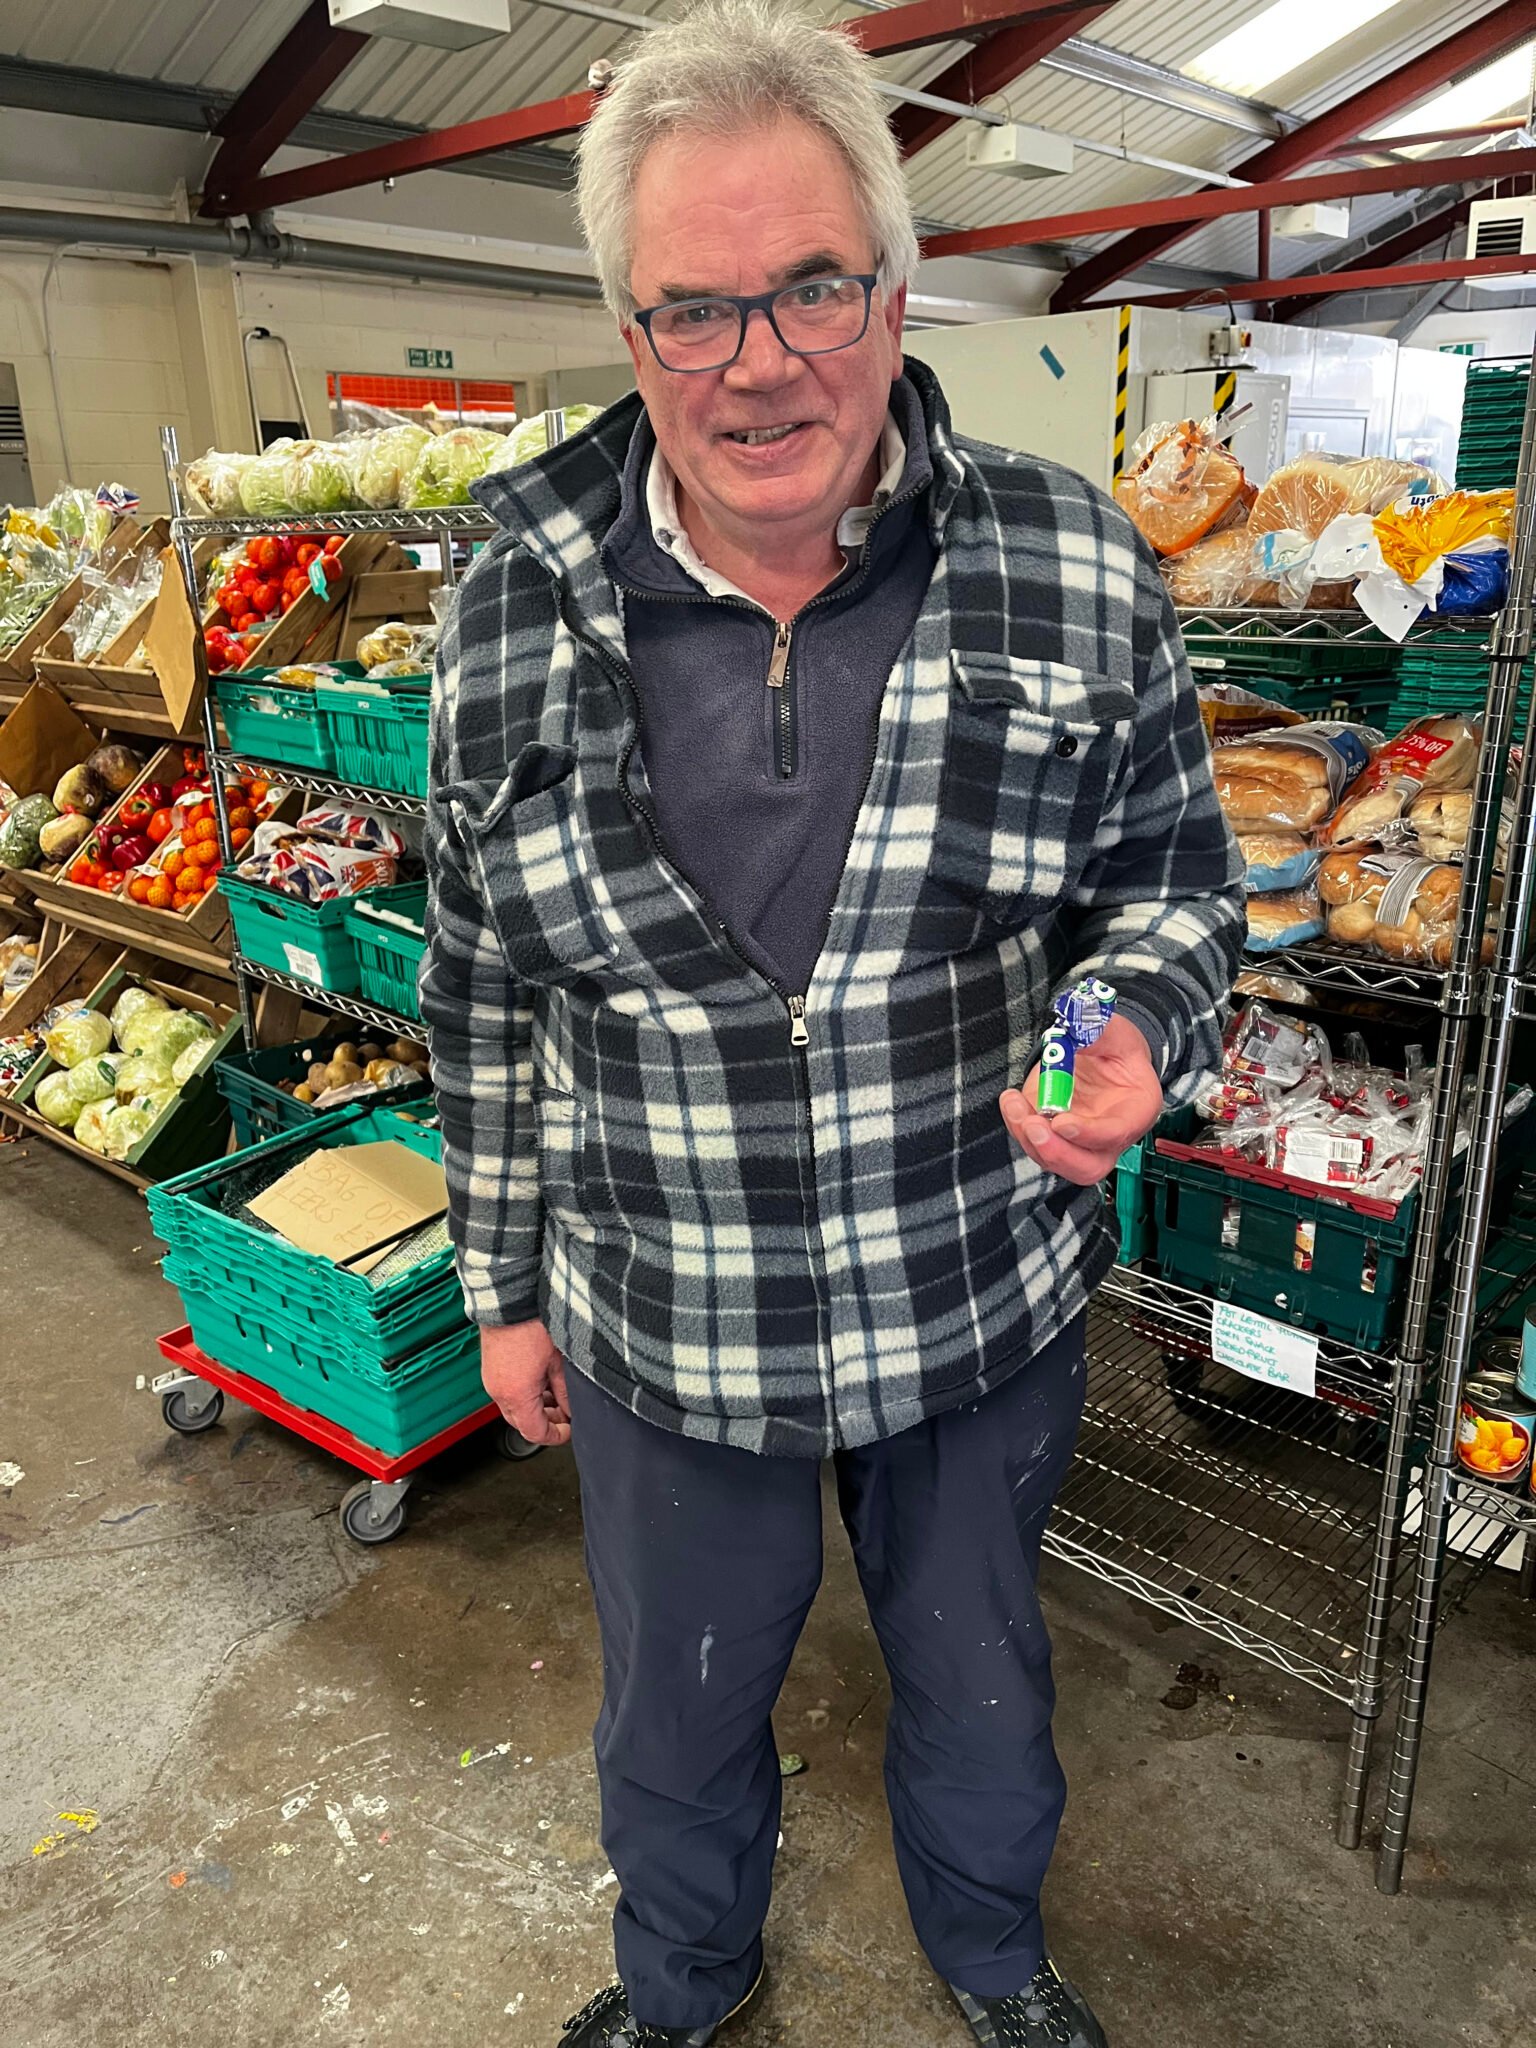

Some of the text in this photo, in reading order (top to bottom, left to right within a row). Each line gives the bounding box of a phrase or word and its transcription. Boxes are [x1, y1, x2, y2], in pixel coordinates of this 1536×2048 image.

[1424, 741, 1448, 754] OFF
[272, 1175, 344, 1223] LEEKS
[304, 1162, 411, 1227] BAG OF
[1267, 1366, 1290, 1383] BAR
